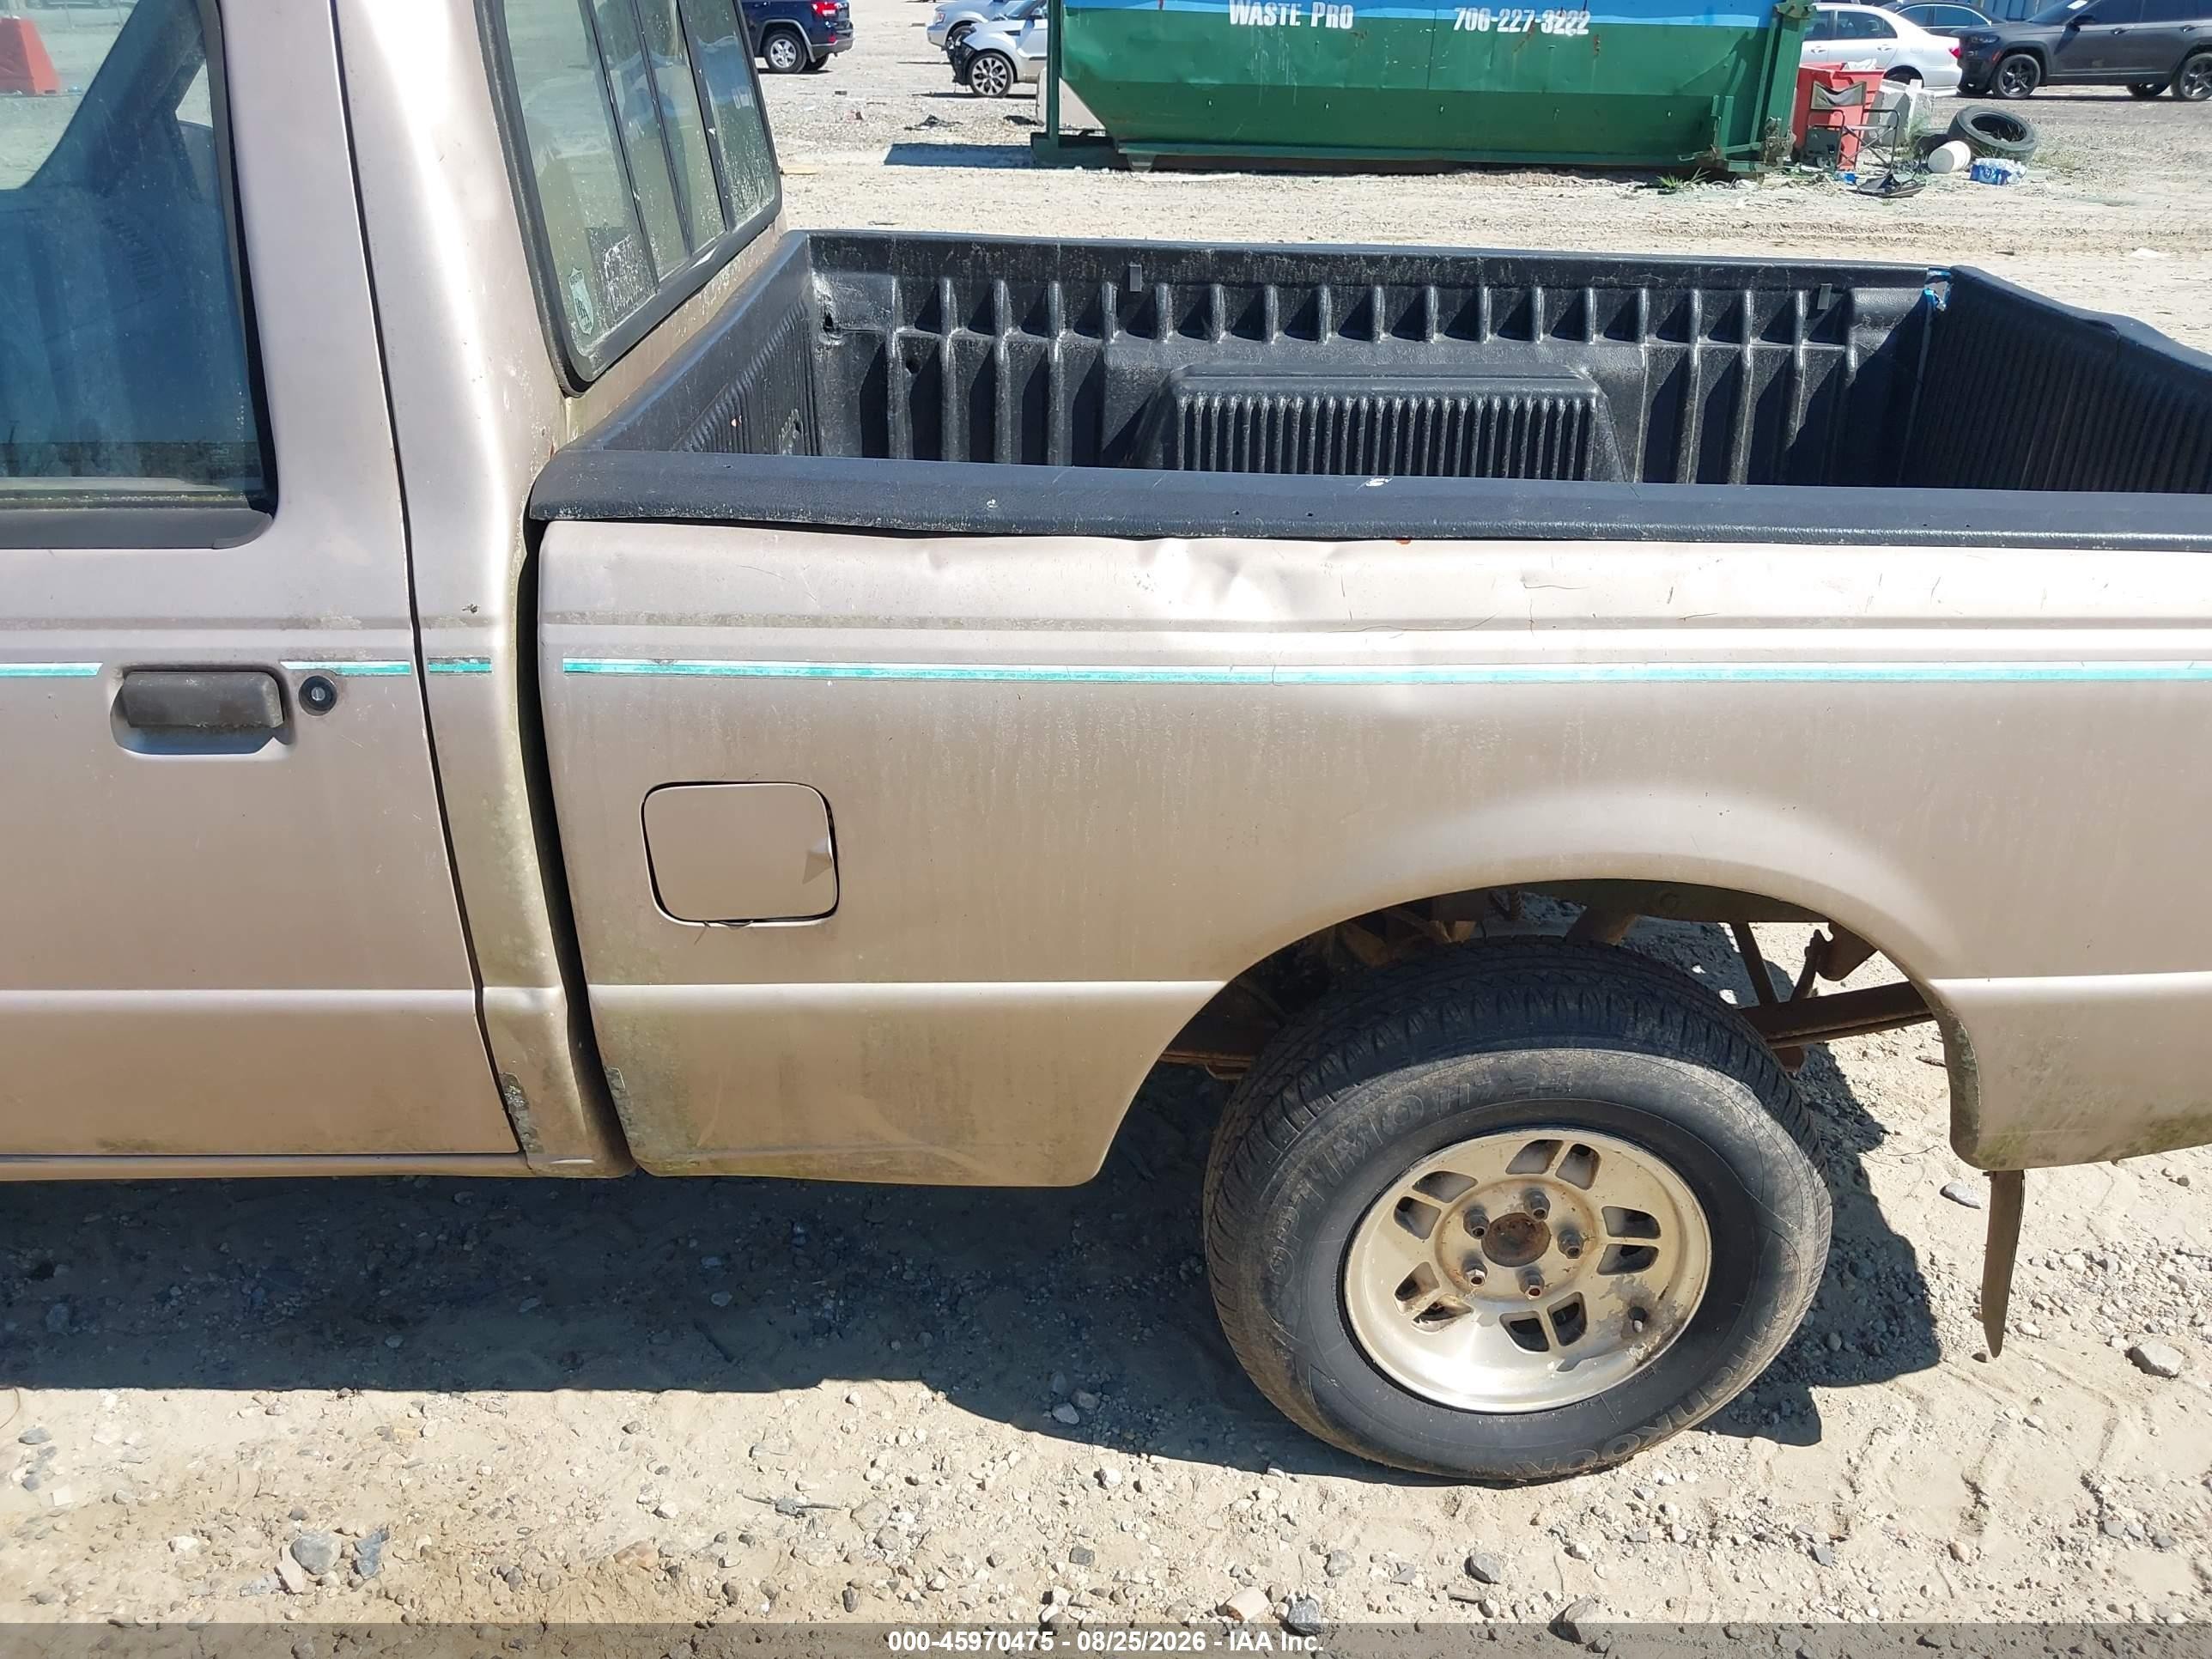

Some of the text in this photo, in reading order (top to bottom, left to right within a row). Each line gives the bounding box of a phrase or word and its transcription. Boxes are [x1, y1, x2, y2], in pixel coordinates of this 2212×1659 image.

[1229, 0, 1354, 29] WASTE PRO
[1453, 8, 1591, 36] 706-227-3222
